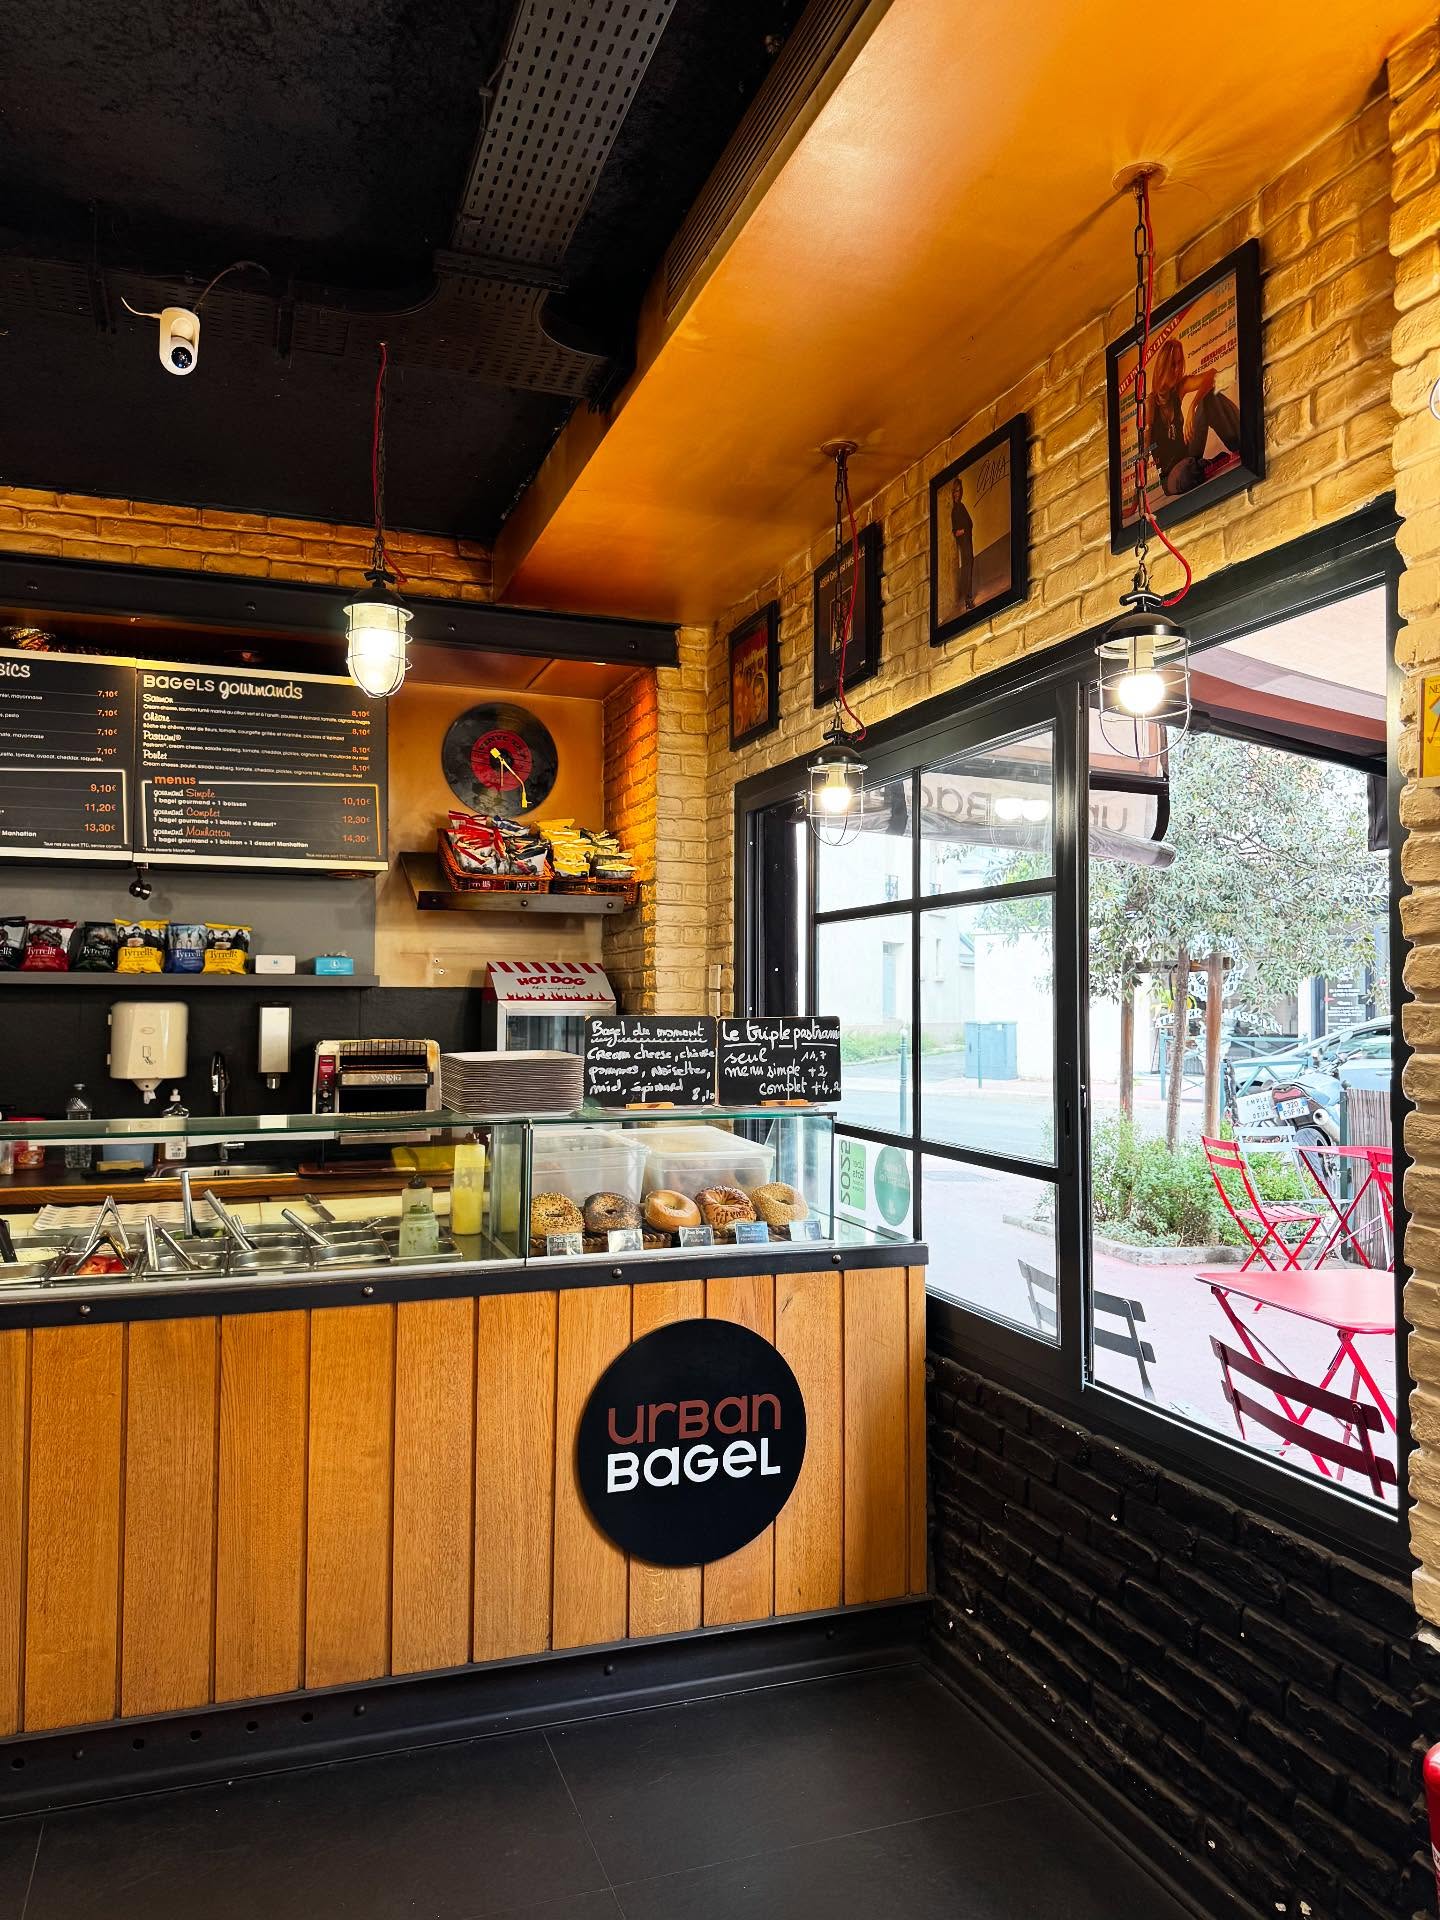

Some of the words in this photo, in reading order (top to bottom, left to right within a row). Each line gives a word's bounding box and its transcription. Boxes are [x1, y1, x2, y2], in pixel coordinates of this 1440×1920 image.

[97, 690, 118, 698] 7,10€
[219, 681, 303, 700] gourmands
[154, 776, 196, 784] menus
[90, 784, 116, 793] 9,10€
[342, 798, 370, 806] 10,10€
[84, 804, 116, 812] 11,20€
[84, 824, 116, 832] 13,30€
[516, 976, 548, 986] HOT
[550, 976, 587, 986] DOG
[592, 1020, 626, 1047] Bagel
[633, 1023, 650, 1036] du
[746, 1020, 791, 1049] triple
[724, 1050, 768, 1066] seul
[725, 1065, 764, 1078] menu
[767, 1058, 800, 1086] simple
[759, 1078, 807, 1101] complet
